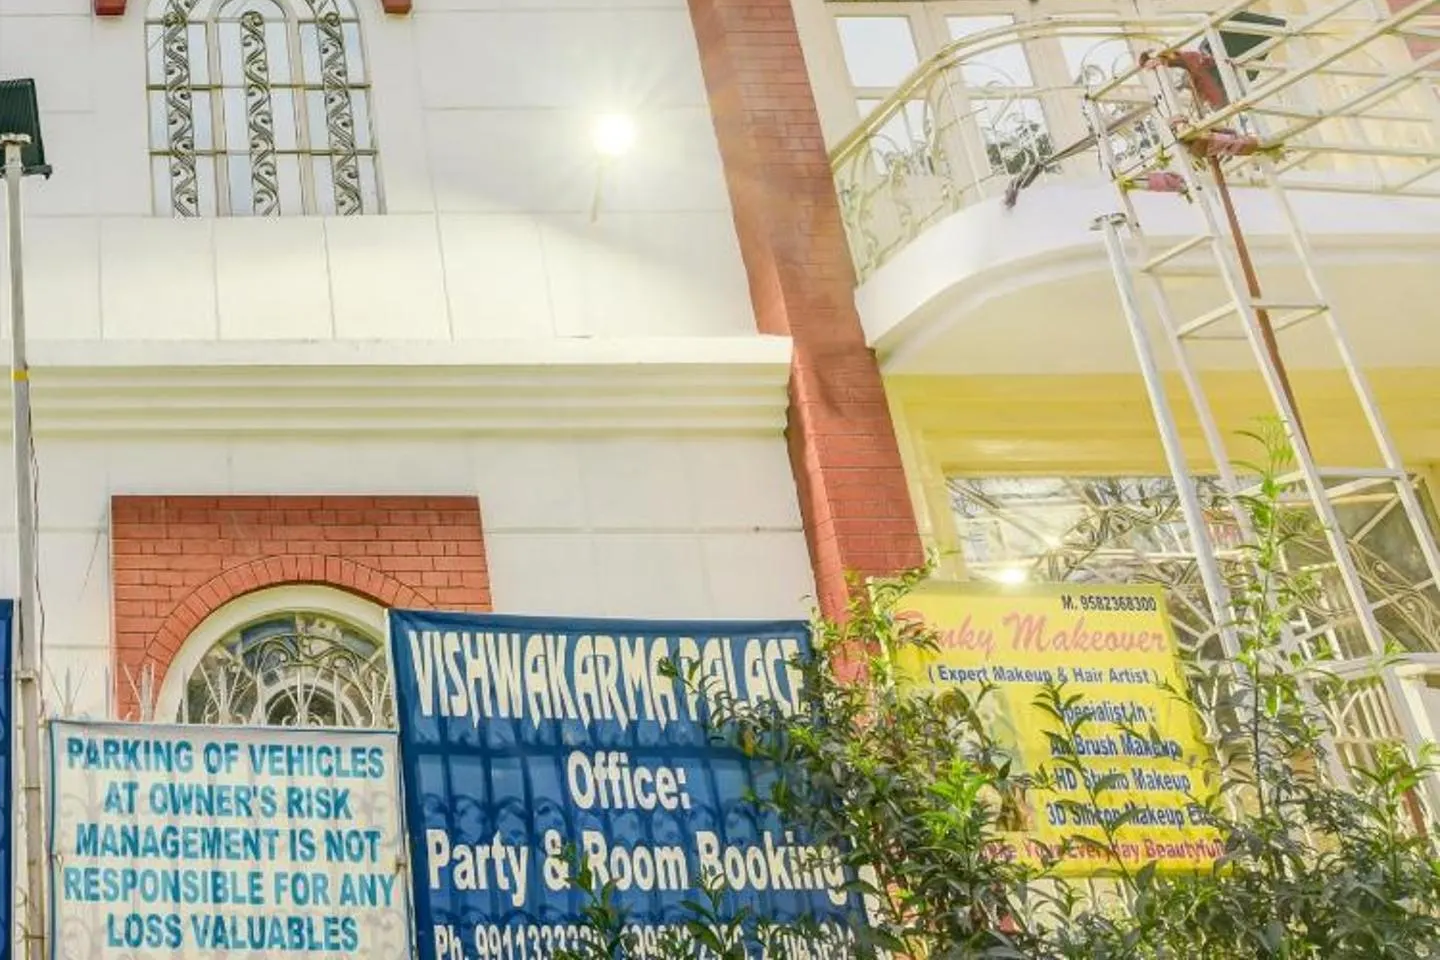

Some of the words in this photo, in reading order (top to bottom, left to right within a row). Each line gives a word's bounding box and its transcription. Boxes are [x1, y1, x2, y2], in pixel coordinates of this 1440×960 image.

[1003, 611, 1165, 652] Makeover
[409, 630, 678, 730] VISHWAKARMA
[939, 666, 988, 684] Expert
[993, 667, 1051, 683] Makeup
[1074, 669, 1103, 683] Hair
[1110, 671, 1148, 684] Artist
[1060, 700, 1126, 723] pecialist
[67, 737, 193, 773] PARKING
[203, 741, 239, 775] OF
[247, 744, 385, 779] VEHICLES
[1074, 735, 1119, 756] Brush
[567, 750, 691, 810] Office:
[1084, 768, 1130, 790] Stuio
[1132, 768, 1191, 793] Makeup
[104, 781, 140, 814] AT
[149, 783, 277, 817] OWNER'S
[286, 786, 352, 820] RISK
[1047, 802, 1067, 825] 3D
[76, 823, 279, 861] MANAGEMENT
[289, 829, 316, 861] IS
[324, 829, 381, 863] NOT
[64, 867, 265, 905] RESPONSIBLE
[274, 873, 330, 906] FOR
[339, 874, 395, 907] ANY
[426, 828, 530, 908] Party
[543, 829, 571, 891] &
[581, 831, 690, 892] Room
[695, 830, 849, 906] Booking
[106, 913, 183, 948] LOSS
[191, 916, 359, 952] VALUABLES
